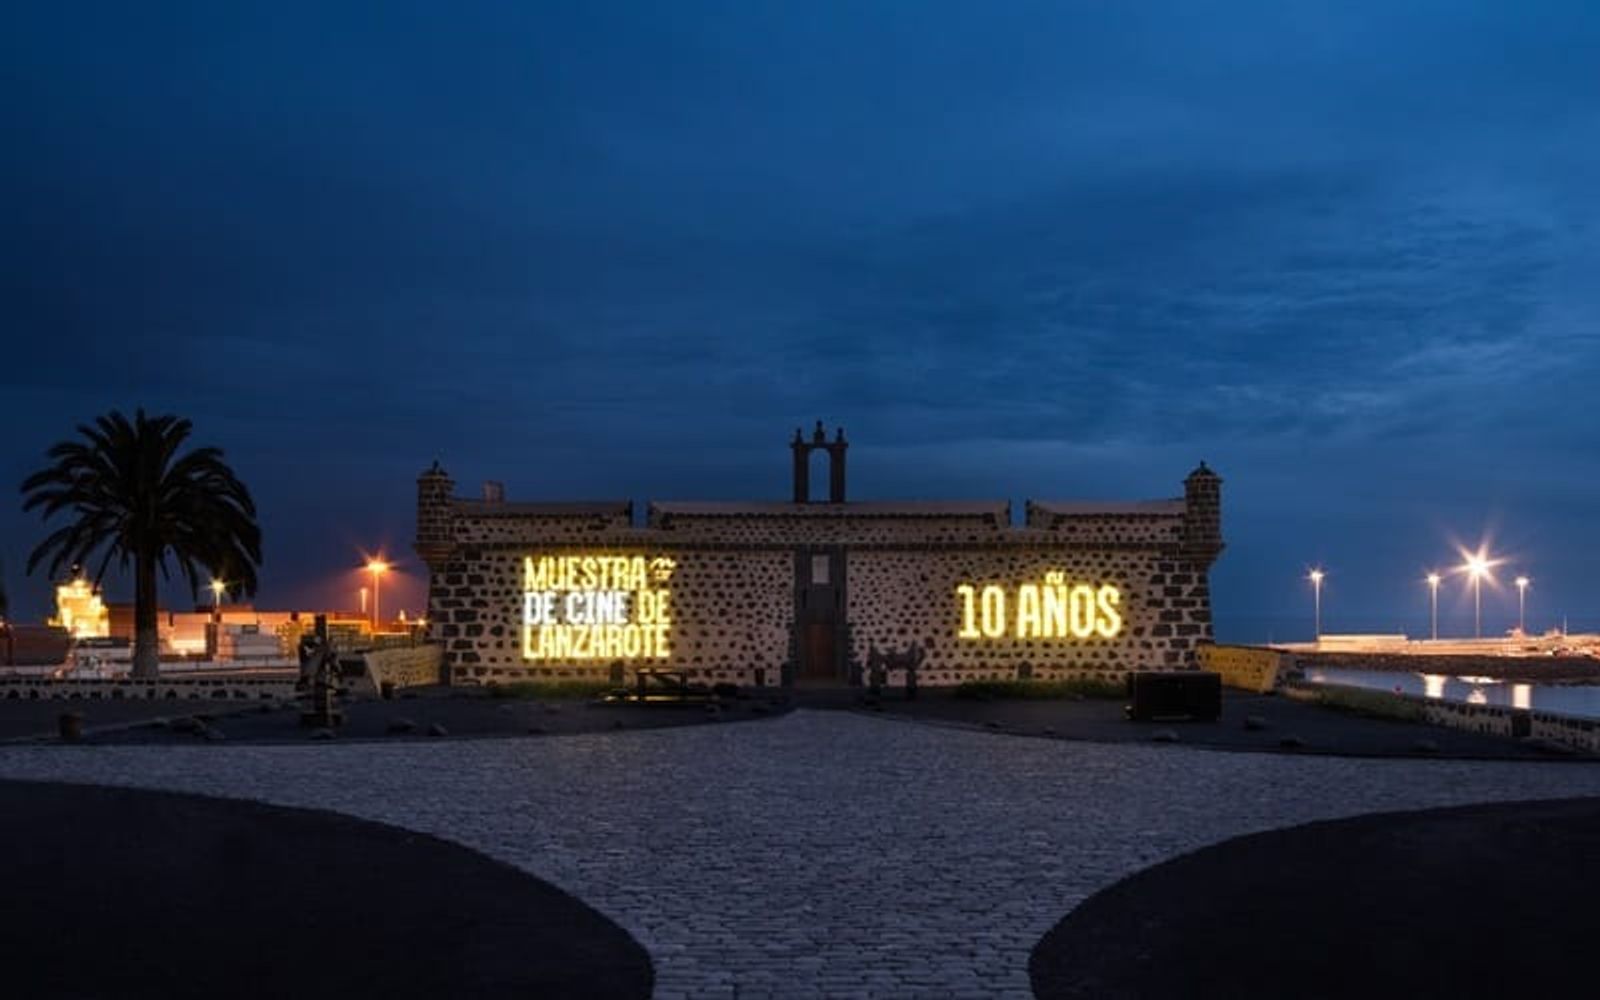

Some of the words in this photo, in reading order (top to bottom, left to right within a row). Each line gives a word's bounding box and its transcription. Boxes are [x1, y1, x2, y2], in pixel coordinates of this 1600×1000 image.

[523, 555, 647, 591] MUESTRA
[524, 591, 558, 624] DE
[565, 590, 630, 624] CINE
[637, 589, 671, 624] DE
[957, 584, 1006, 638] 10
[1016, 571, 1122, 638] AÑOS
[523, 624, 671, 659] LANZAROTE
